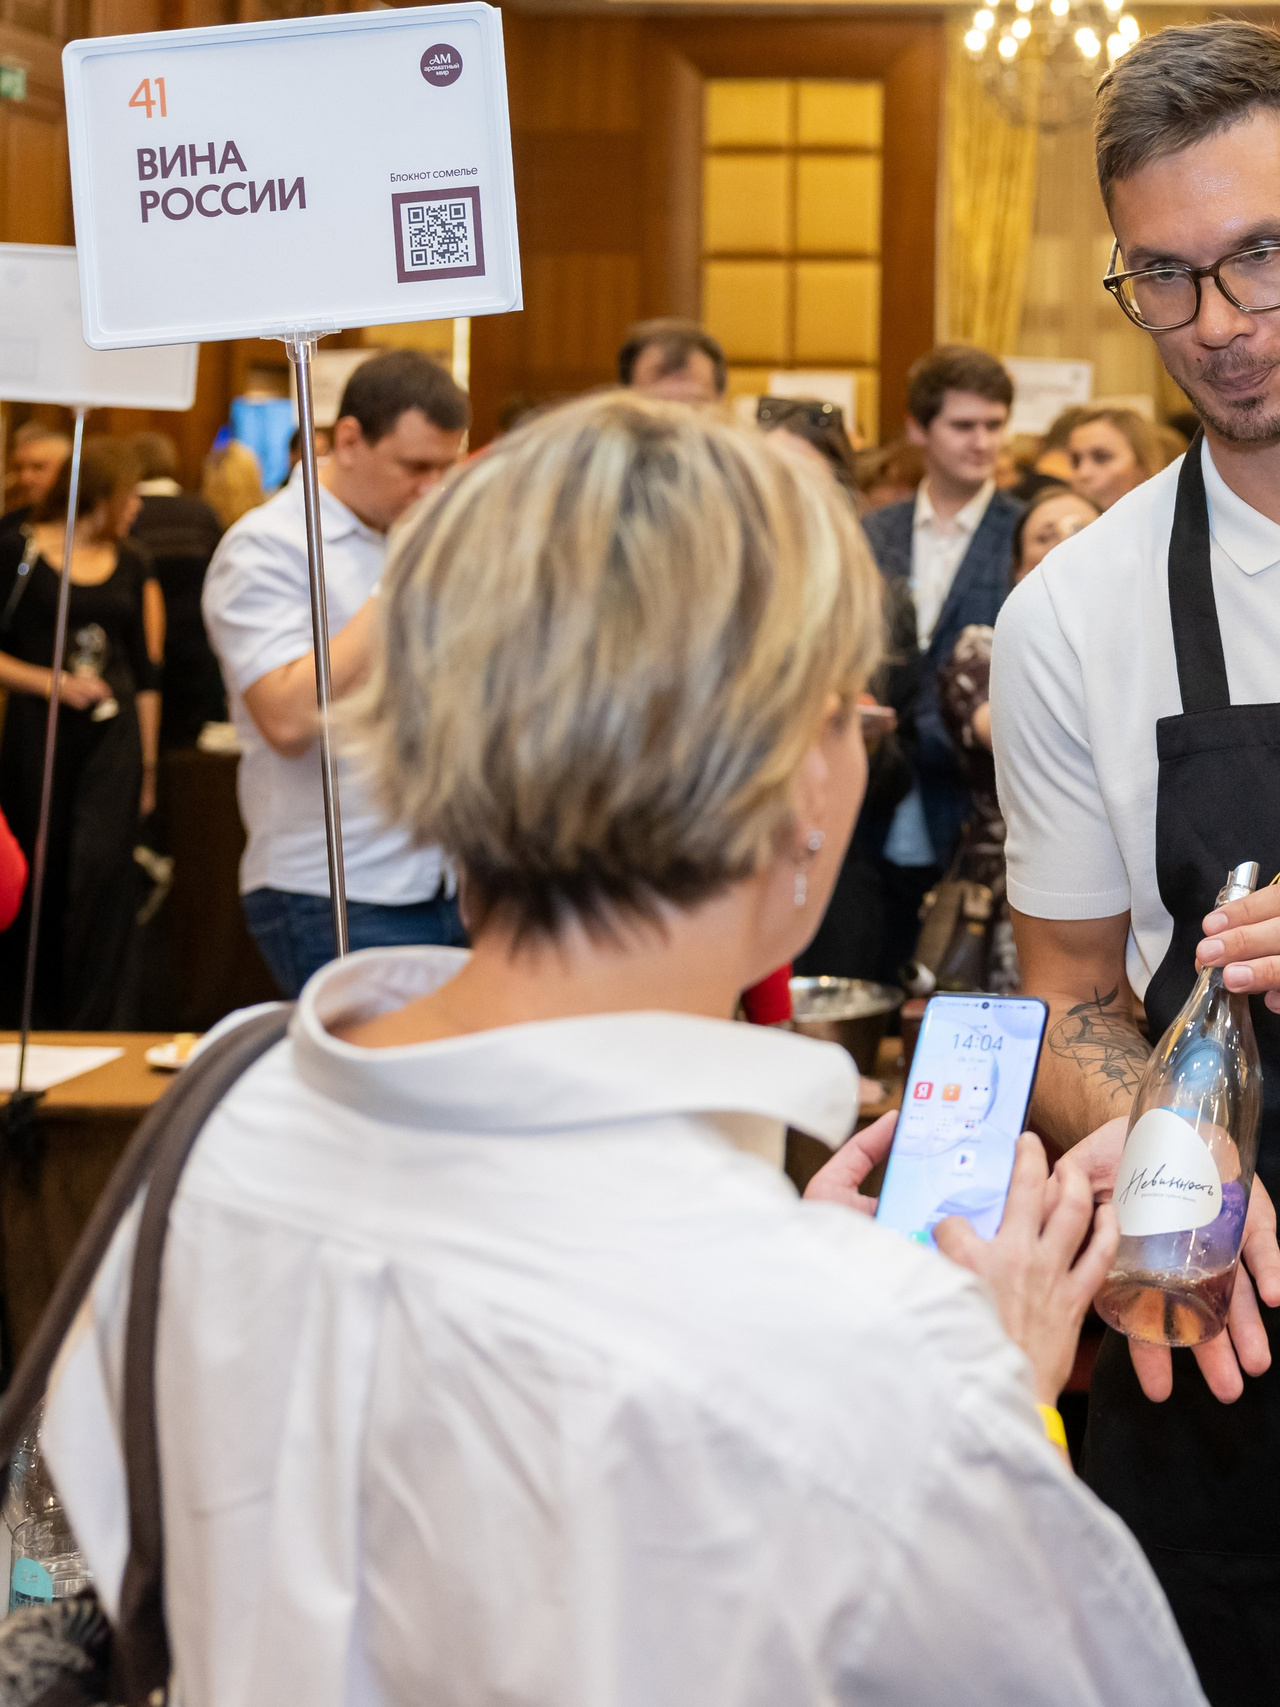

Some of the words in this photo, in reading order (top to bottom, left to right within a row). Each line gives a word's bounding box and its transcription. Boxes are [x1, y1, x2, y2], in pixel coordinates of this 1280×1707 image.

[128, 77, 167, 119] 41
[136, 140, 248, 181] ВИНА
[390, 171, 431, 183] Блокнот
[432, 167, 479, 179] сомелье
[140, 176, 307, 223] РОССИИ
[953, 1033, 1004, 1052] 14:04
[1119, 1163, 1214, 1205] Невинность
